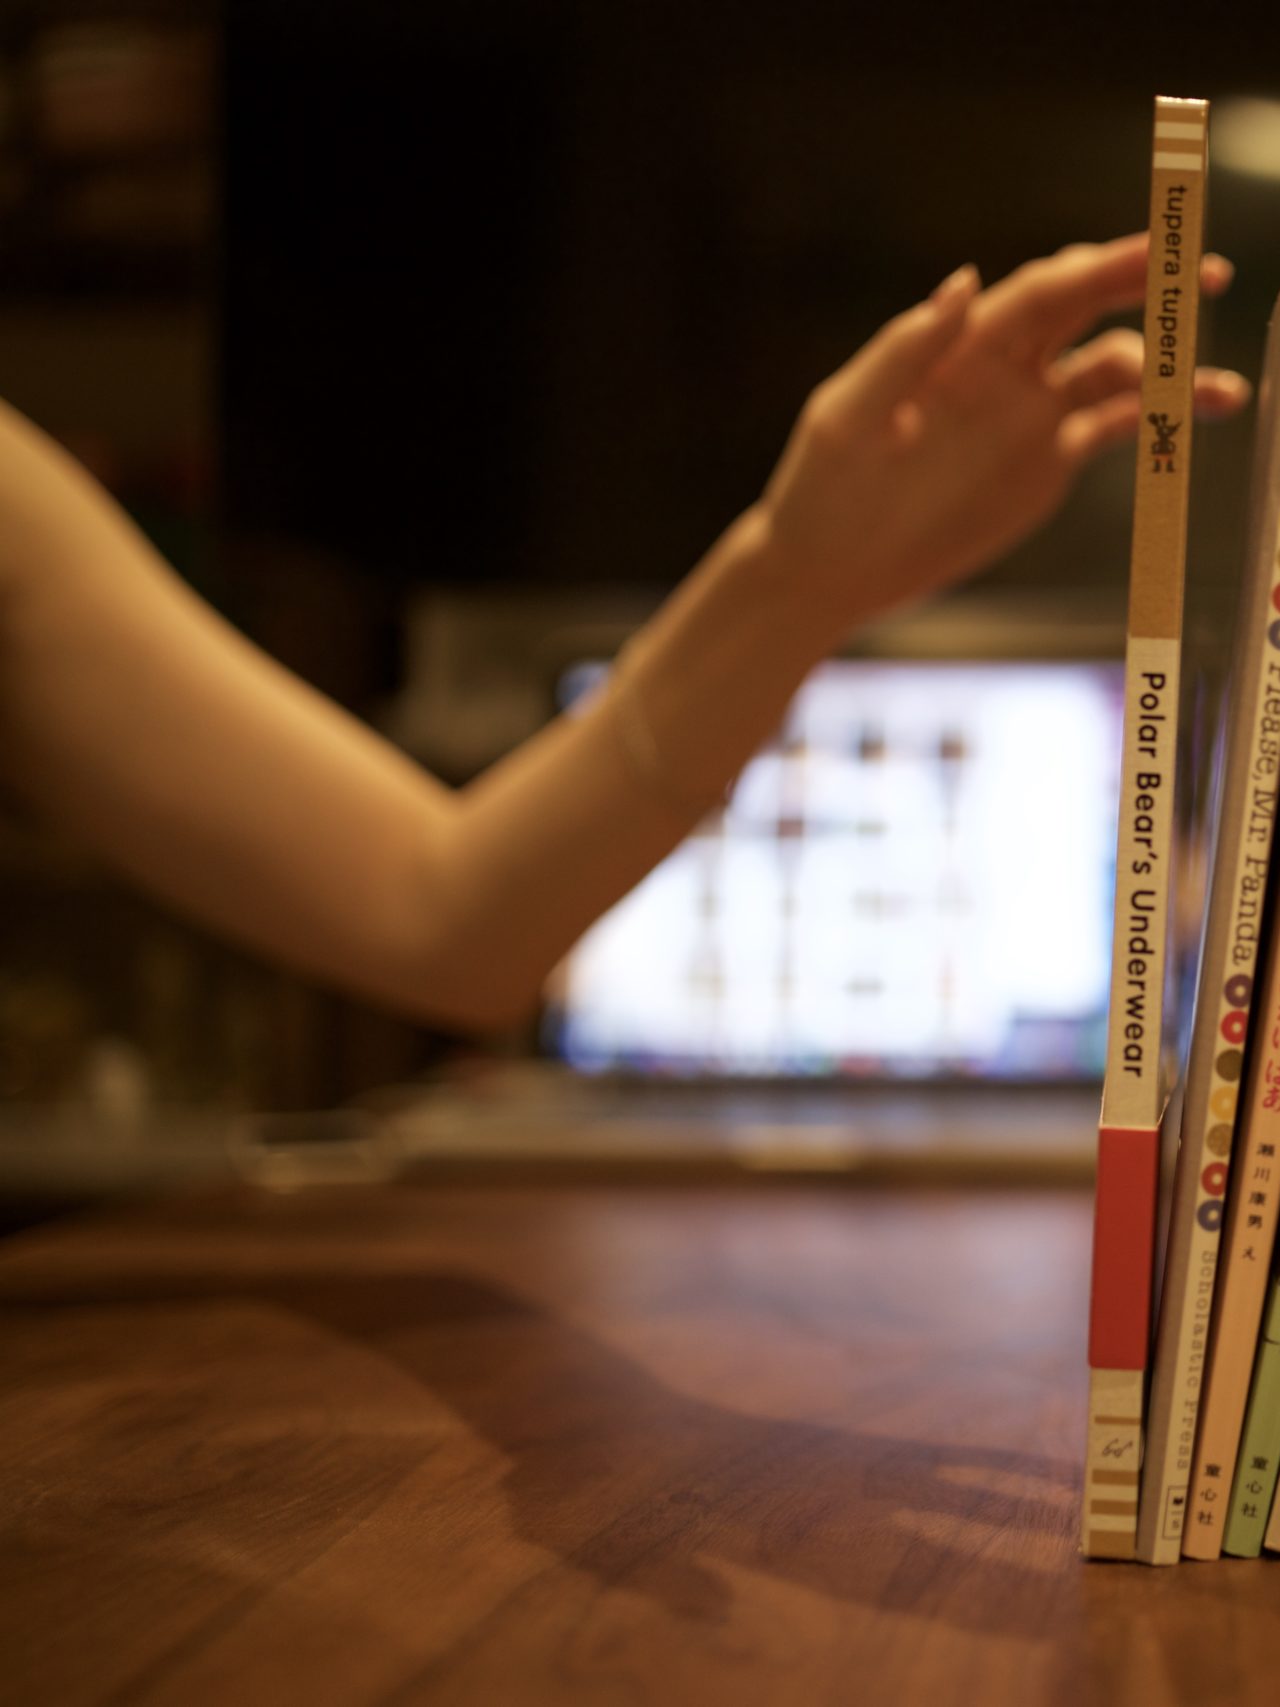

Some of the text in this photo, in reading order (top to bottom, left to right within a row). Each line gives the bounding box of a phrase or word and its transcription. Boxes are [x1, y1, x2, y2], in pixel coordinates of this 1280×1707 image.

[1157, 185, 1187, 378] tupera tupera
[1247, 786, 1276, 843] Mr.
[1123, 671, 1166, 1078] Polar Bear's Underwear
[1232, 853, 1267, 966] Panda
[1196, 1462, 1222, 1527] 童心社
[1241, 1455, 1269, 1520] 童心社
